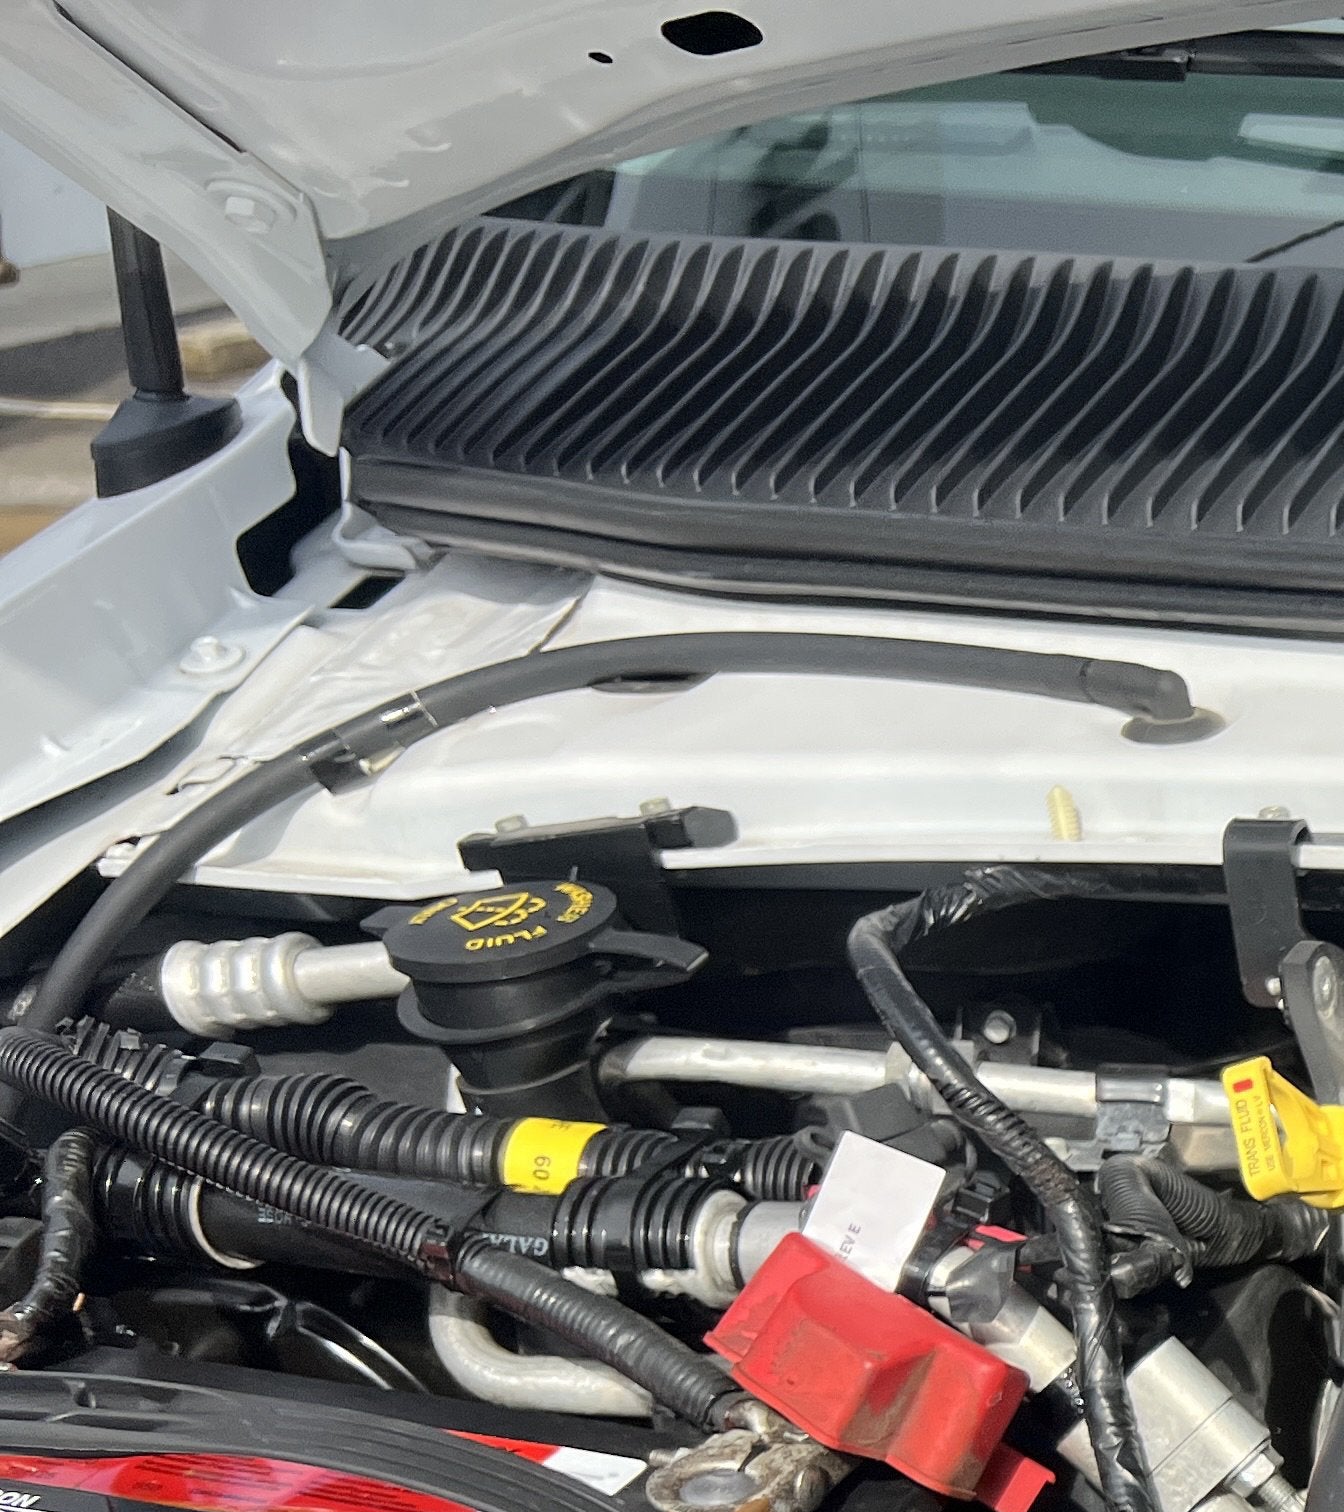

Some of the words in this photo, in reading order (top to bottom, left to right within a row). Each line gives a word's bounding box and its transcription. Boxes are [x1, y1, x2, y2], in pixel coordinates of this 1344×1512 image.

[465, 925, 548, 951] FLUID
[1235, 1099, 1253, 1133] FLUID
[1243, 1137, 1261, 1177] TRANS
[0, 1488, 41, 1508] ON
